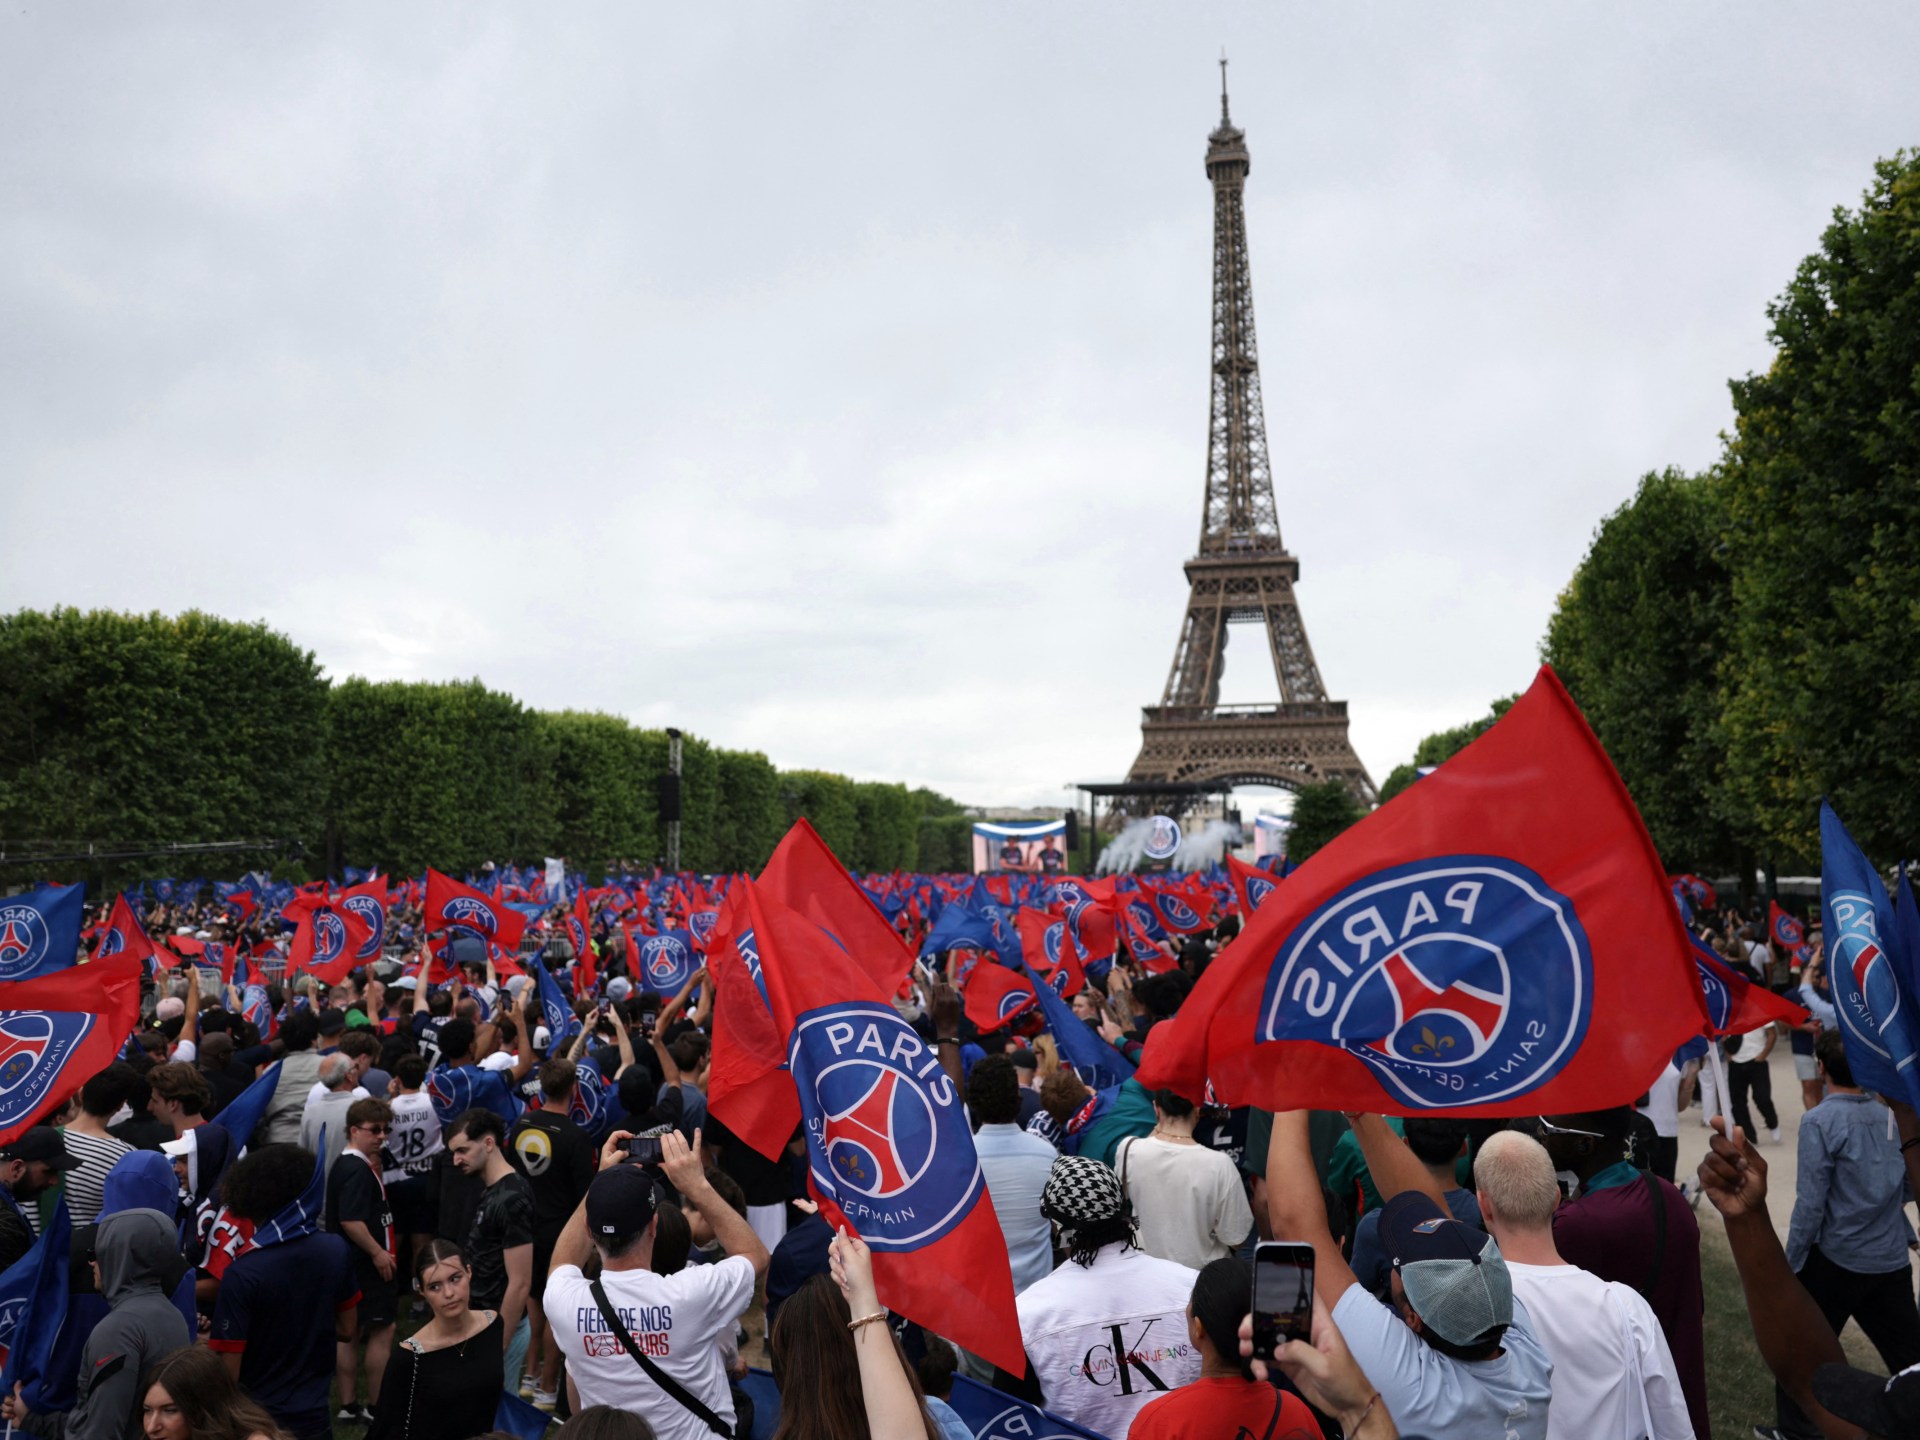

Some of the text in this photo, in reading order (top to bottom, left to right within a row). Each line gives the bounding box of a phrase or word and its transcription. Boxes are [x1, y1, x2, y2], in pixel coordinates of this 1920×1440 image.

[646, 938, 681, 953] PARIS
[1849, 991, 1875, 1028] SAIN
[24, 1039, 66, 1098] GERMAIN
[418, 1039, 442, 1072] 17
[826, 1022, 958, 1107] PARIS
[398, 1128, 425, 1158] 18
[808, 1117, 915, 1225] SAI ERMAIN
[577, 1305, 672, 1333] FIER DE NOS
[1069, 1356, 1115, 1377] CALVIN
[1151, 1344, 1188, 1362] JEANS
[1083, 1318, 1178, 1397] CK
